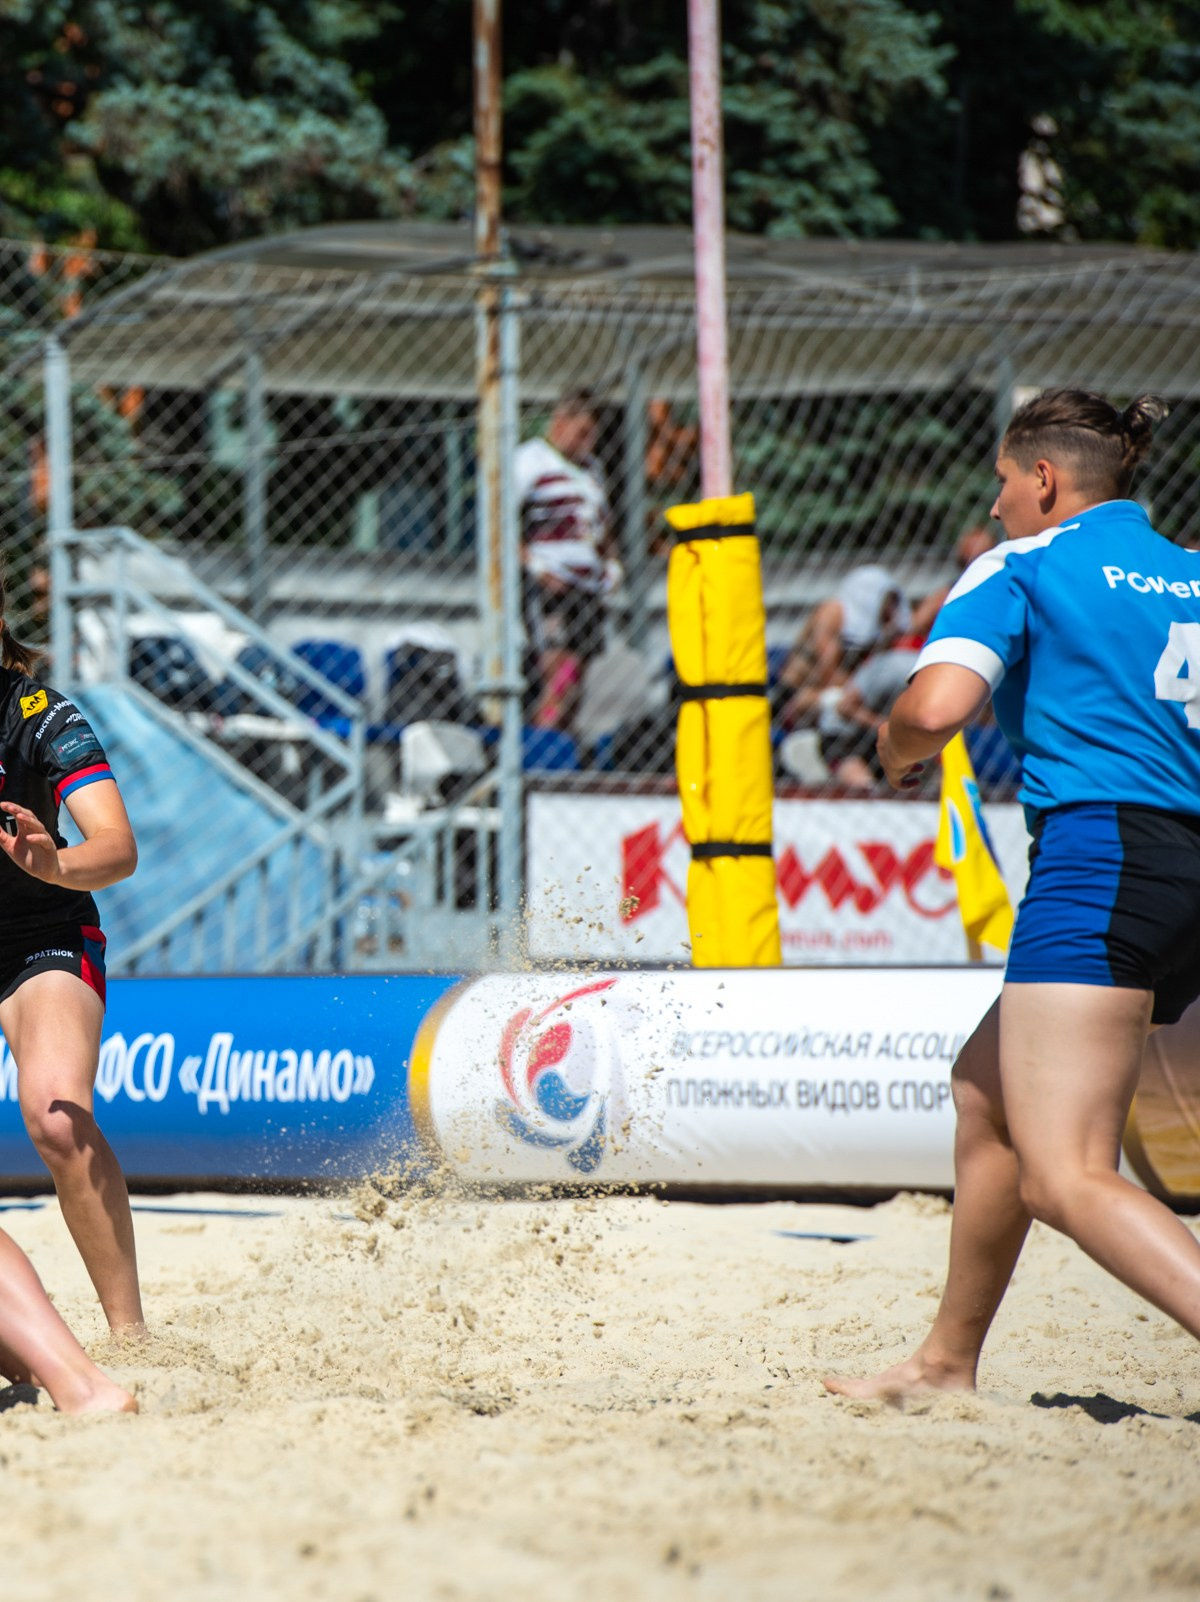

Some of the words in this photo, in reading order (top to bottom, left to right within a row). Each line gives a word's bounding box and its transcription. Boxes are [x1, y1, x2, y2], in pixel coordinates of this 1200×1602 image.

[1154, 621, 1200, 729] 4
[34, 949, 74, 960] PATRICK
[672, 1027, 873, 1058] ВСЕРОССИЙСКАЯ
[178, 1031, 376, 1115] «Динамо»
[667, 1078, 788, 1108] ПЛЯЖНЫХ
[795, 1080, 880, 1114] ВИДОВ
